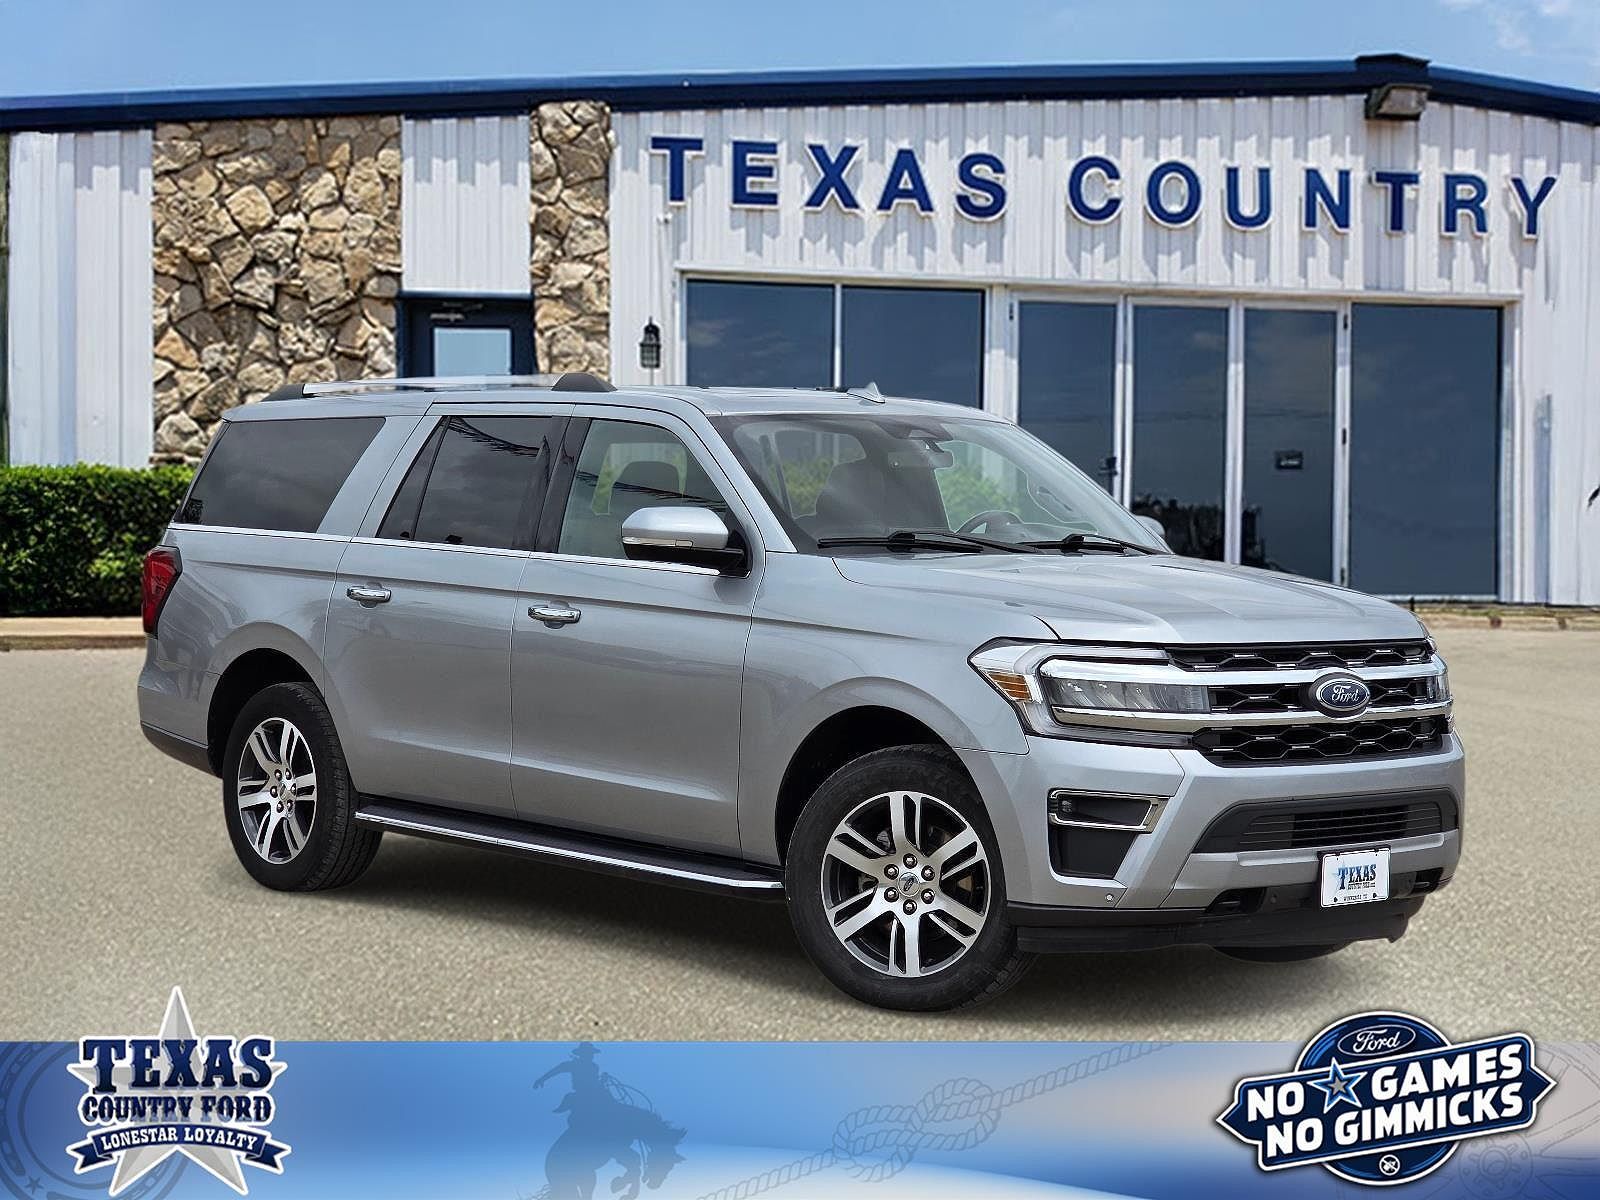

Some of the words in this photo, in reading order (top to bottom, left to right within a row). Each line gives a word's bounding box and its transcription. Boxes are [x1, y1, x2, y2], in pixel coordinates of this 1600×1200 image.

[649, 135, 1007, 222] TEXAS
[1066, 154, 1557, 240] COUNTRY
[1331, 684, 1360, 703] Ford
[1338, 864, 1377, 890] TEXAS
